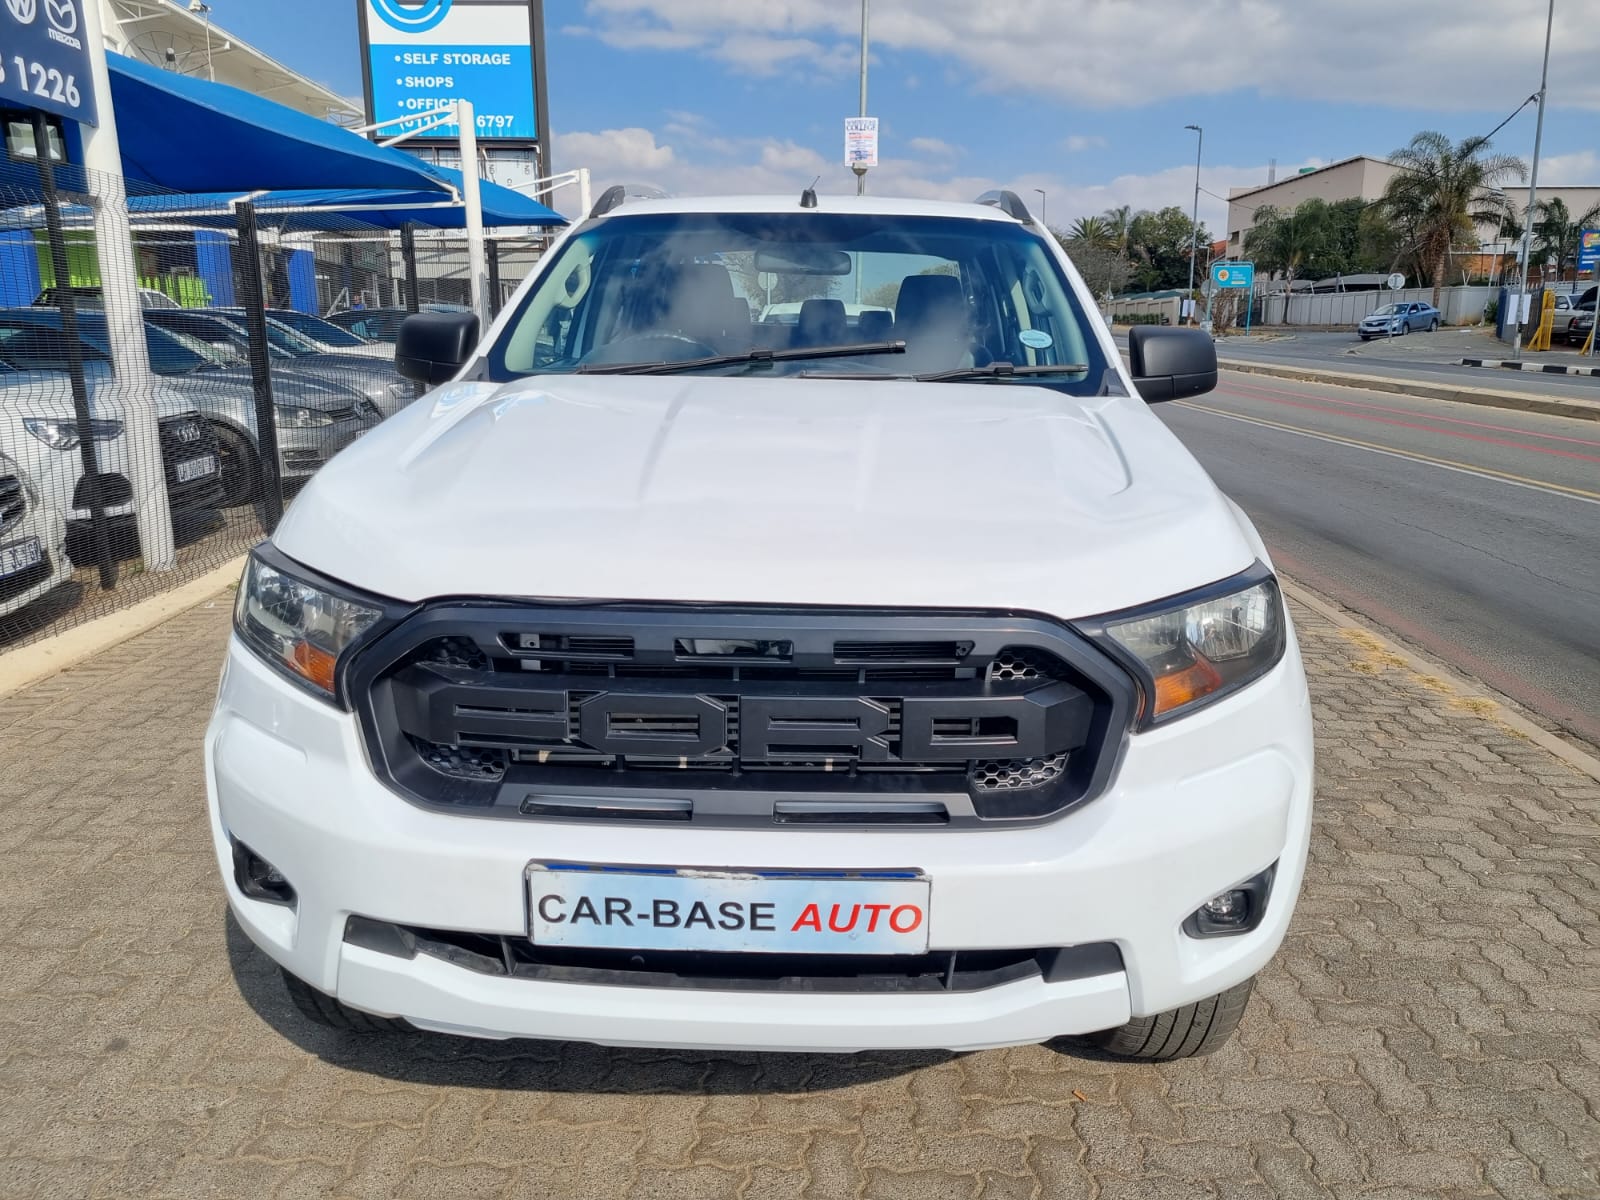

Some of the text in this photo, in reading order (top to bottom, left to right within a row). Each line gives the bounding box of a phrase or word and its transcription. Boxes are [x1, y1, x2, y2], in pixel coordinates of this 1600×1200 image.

[48, 28, 81, 51] mazda
[403, 53, 511, 65] SELF STORAGE
[14, 56, 80, 108] 1226
[405, 77, 454, 88] SHOPS
[476, 115, 514, 128] 6797
[429, 686, 1047, 760] FORD
[538, 894, 923, 934] CAR-BASE AUTO
